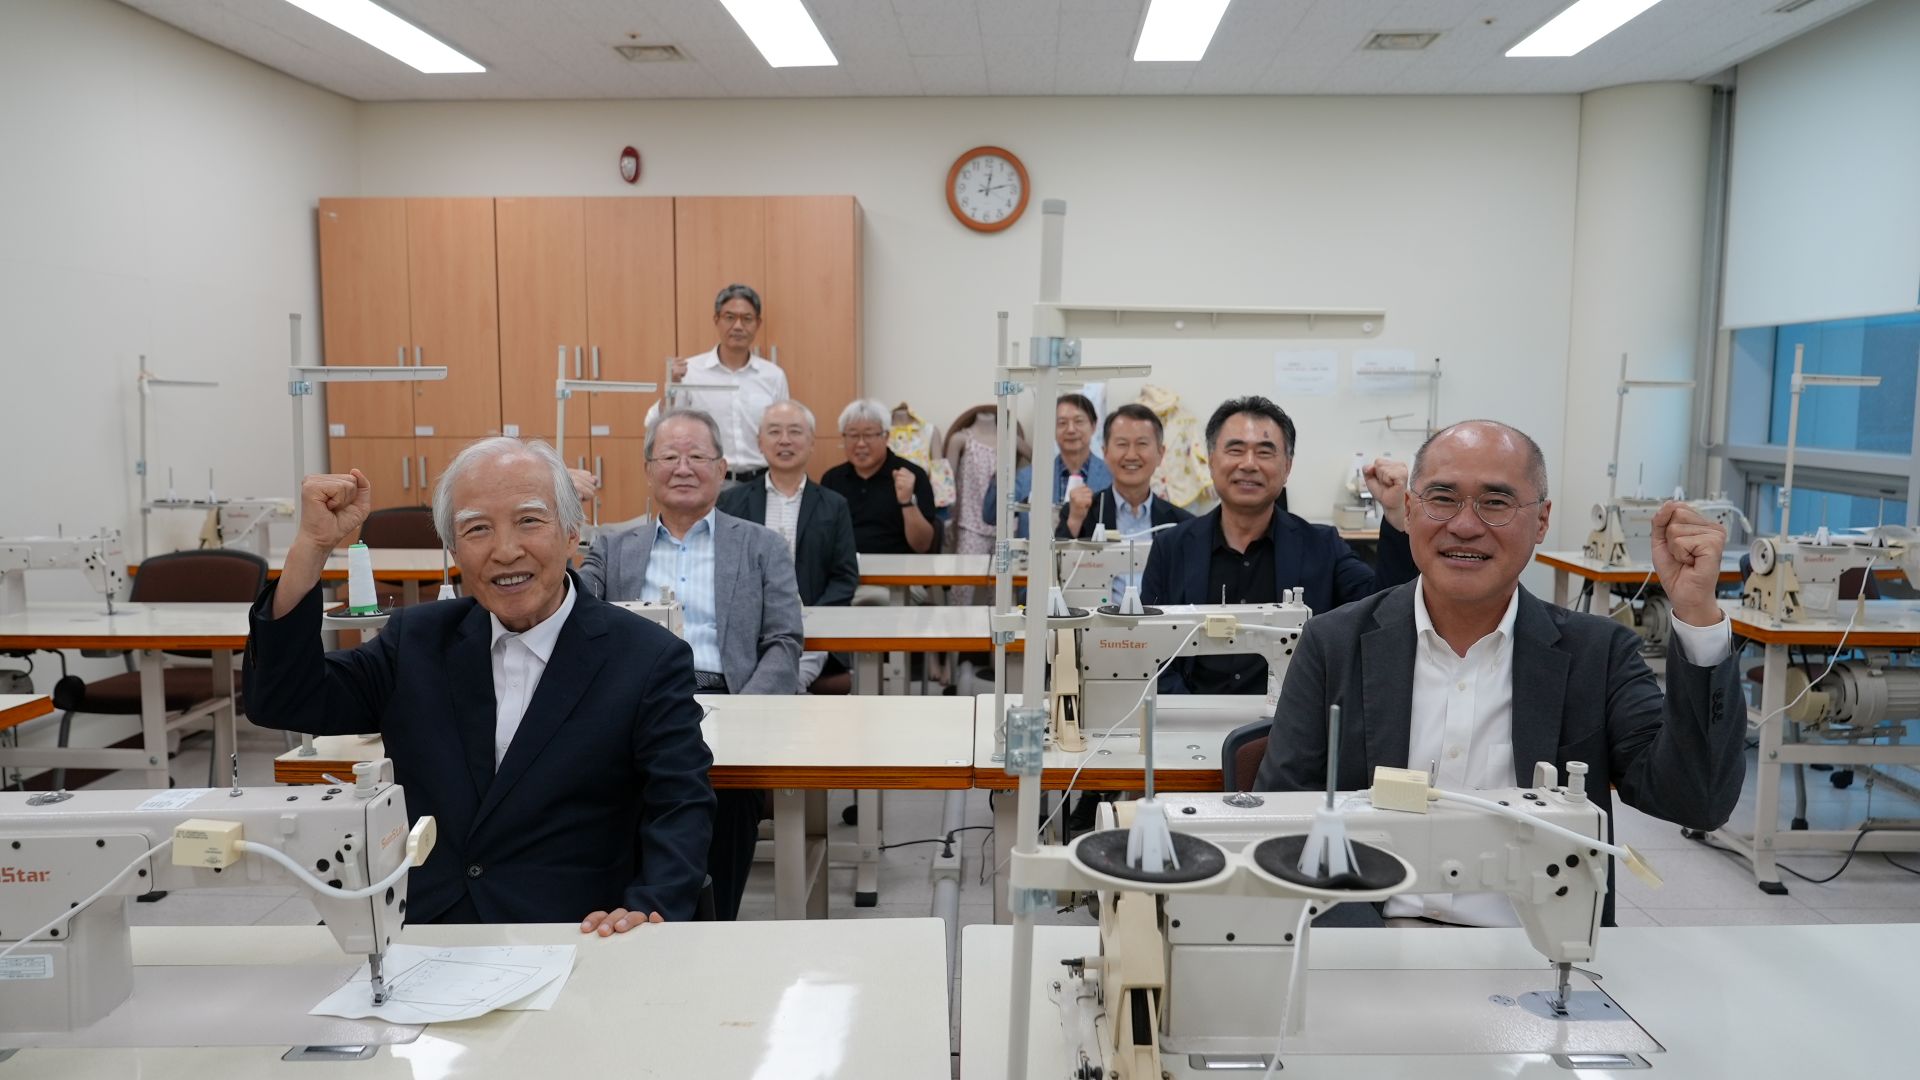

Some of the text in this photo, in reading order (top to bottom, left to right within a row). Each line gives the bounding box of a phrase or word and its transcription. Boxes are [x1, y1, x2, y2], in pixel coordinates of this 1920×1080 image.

[985, 157, 994, 169] 12
[1099, 639, 1148, 649] SunStar
[0, 867, 51, 882] Star
